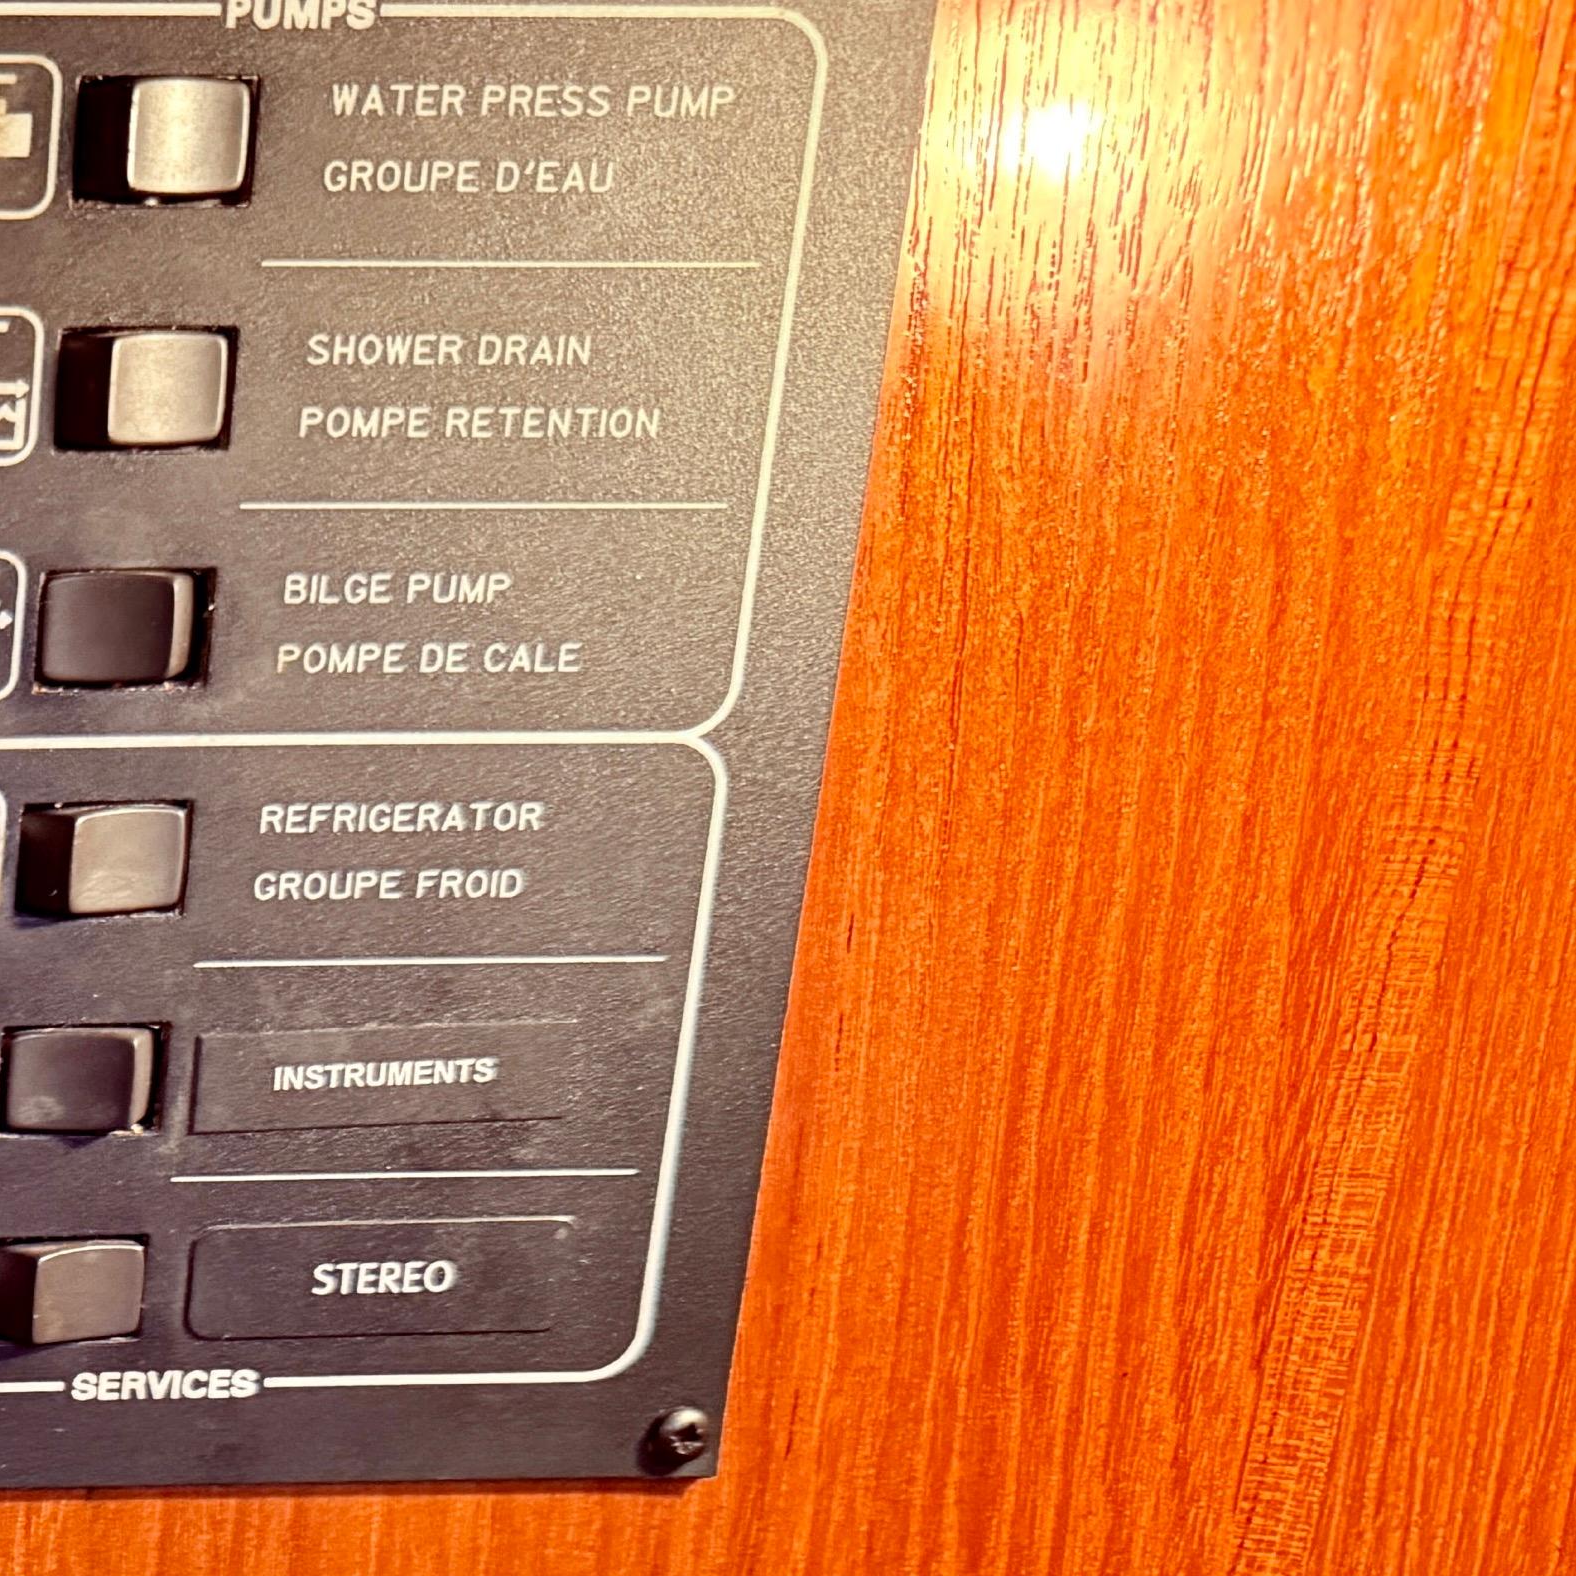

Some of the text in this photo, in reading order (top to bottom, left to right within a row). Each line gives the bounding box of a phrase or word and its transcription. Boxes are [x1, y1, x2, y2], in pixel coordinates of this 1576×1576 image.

[225, 0, 377, 30] PUMPS
[332, 82, 739, 121] WATER PRESS PUMP
[324, 157, 619, 194] GROUPE D'EAU
[307, 333, 592, 367] SHOWER DRAIN
[299, 403, 663, 440] POMPE RETENTION
[283, 572, 513, 605] BILGE PUMP
[277, 641, 583, 674] POMPE DE CALE
[259, 801, 545, 834] REFRIGERATOR
[254, 868, 524, 901] GROUPE FROID
[273, 1057, 498, 1091] INSTRUMENTS
[311, 1260, 457, 1296] STEREO
[70, 1368, 260, 1401] SERVICES
